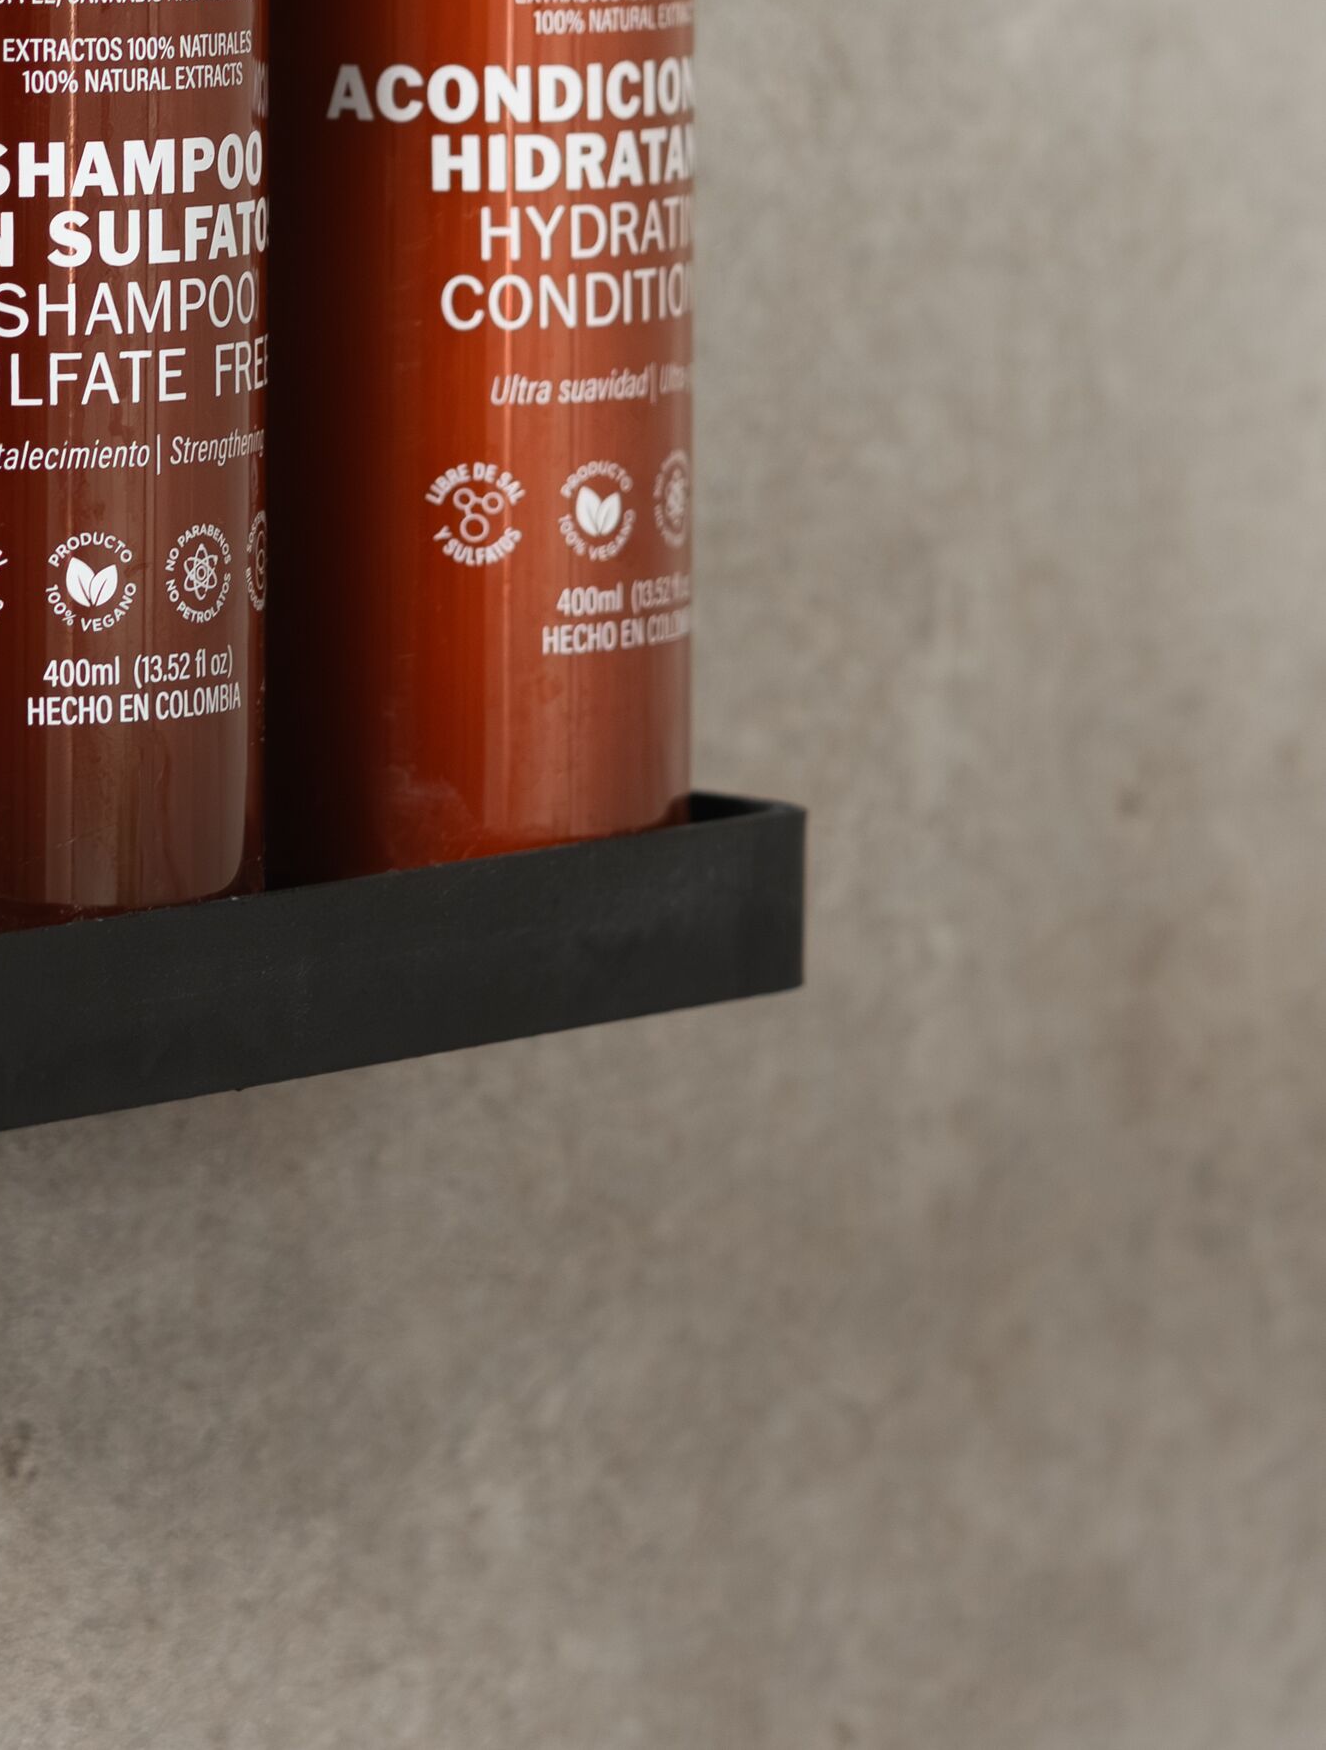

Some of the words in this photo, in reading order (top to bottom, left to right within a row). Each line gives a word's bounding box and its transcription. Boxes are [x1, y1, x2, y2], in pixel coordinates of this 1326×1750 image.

[534, 9, 585, 35] 100%
[588, 5, 656, 33] NATURAL
[2, 36, 122, 63] EXTRACTOS
[127, 35, 175, 60] 100%
[179, 29, 252, 58] NATURALES
[22, 69, 78, 94] 100%
[85, 65, 171, 94] NATURAL
[175, 62, 243, 90] EXTRACTS
[47, 196, 269, 267] SULFATO
[490, 373, 552, 405] Ultra
[558, 364, 649, 404] suavidad
[170, 425, 264, 467] Strengthening
[425, 462, 471, 506] LIBRE
[472, 461, 498, 482] DE
[495, 471, 526, 507] SAL
[560, 460, 633, 499] PRODUCTO
[47, 531, 133, 568] PRODUCTO
[165, 547, 179, 572] NO
[177, 523, 231, 564] PARABENOS
[433, 525, 451, 542] Y
[443, 526, 522, 566] SULFATOS
[588, 508, 636, 561] VEGANO
[45, 584, 76, 626] 100%
[80, 582, 137, 632] VEGANO
[166, 579, 179, 603] NO
[176, 572, 231, 623] PETROLATOS
[556, 582, 623, 616] 400ml
[542, 620, 617, 656] HECHO
[621, 617, 645, 648] EN
[43, 656, 120, 688] 400ml
[134, 653, 191, 689] (13.52
[195, 649, 206, 678] fl
[210, 644, 233, 678] oz)
[27, 695, 112, 726] HECHO
[120, 692, 149, 722] EN
[155, 682, 241, 720] COLOMBIA
